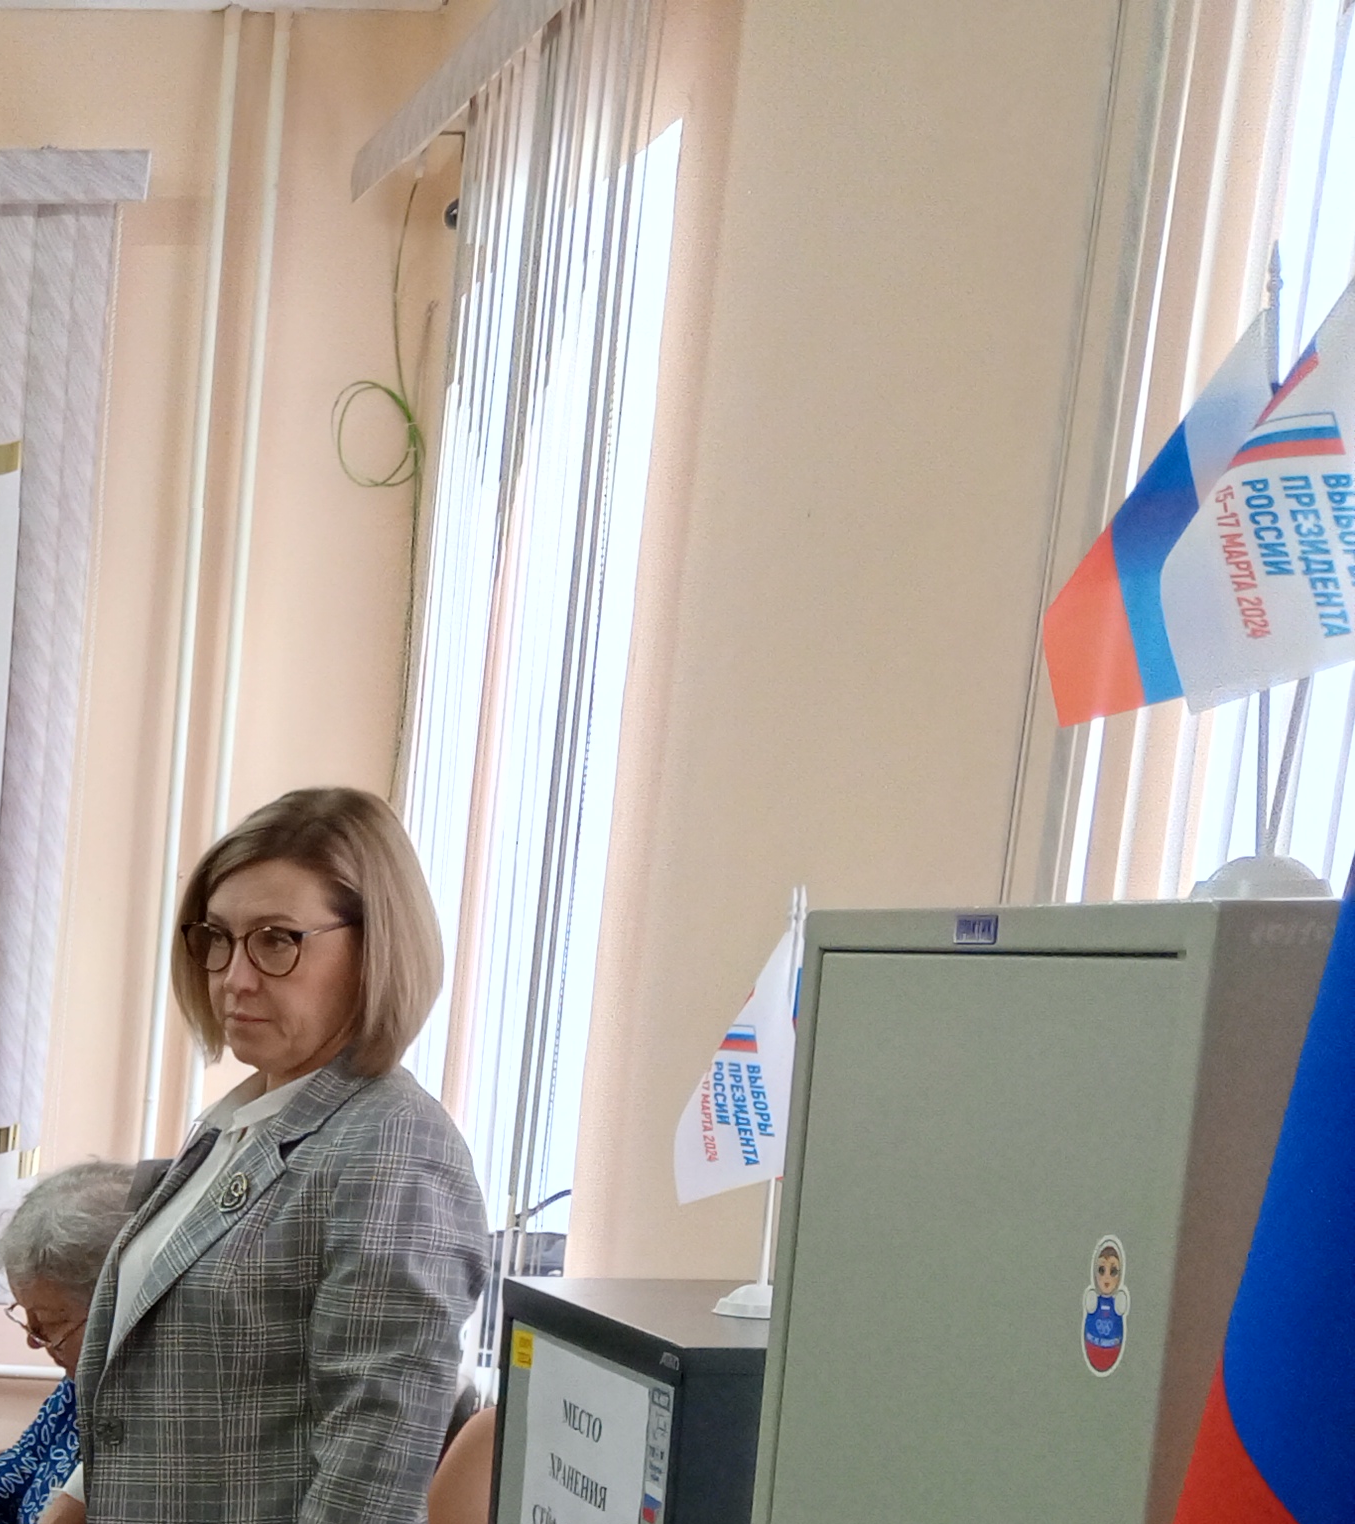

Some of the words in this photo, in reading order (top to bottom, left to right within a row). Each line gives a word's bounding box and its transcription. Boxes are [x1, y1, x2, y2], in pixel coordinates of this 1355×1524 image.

[1242, 477, 1295, 577] РОССИИ
[1280, 474, 1351, 639] ПРЕЗИДЕНТА
[1219, 532, 1258, 593] МАРТА
[1236, 596, 1272, 640] 2024
[700, 1093, 714, 1133] МАРТА
[713, 1060, 731, 1126] РОССИИ
[728, 1061, 760, 1167] ПРЕЗИДЕНТА
[746, 1063, 775, 1138] ВЫБОРЫ
[562, 1398, 603, 1444] МЕСТО
[548, 1452, 608, 1512] ХРАНЕНИЯ
